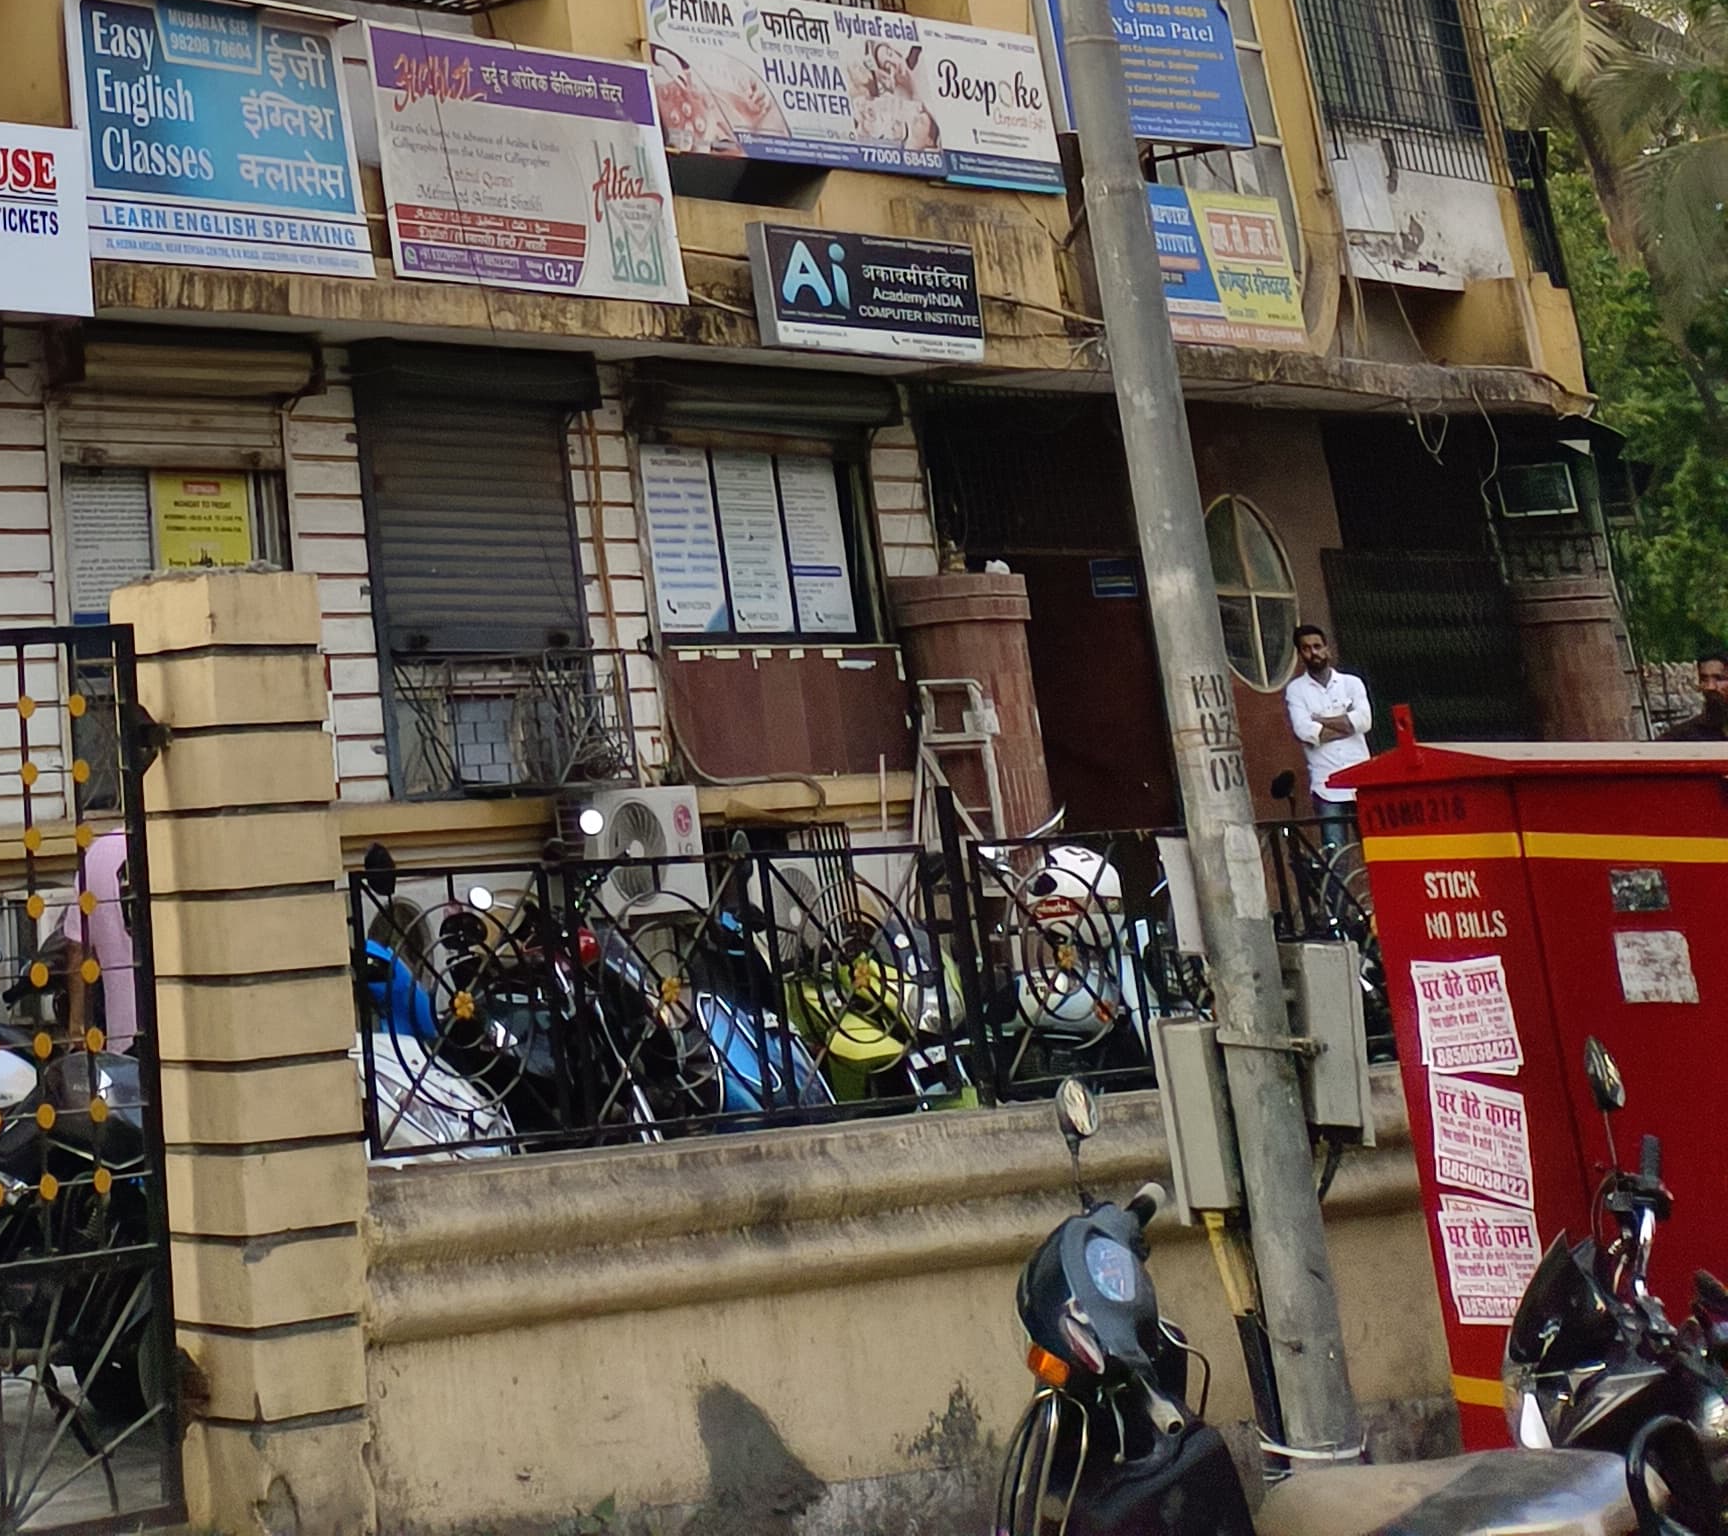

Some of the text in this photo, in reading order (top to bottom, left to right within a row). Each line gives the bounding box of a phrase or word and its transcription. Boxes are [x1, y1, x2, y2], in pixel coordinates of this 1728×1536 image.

[168, 8, 226, 35] MUBARAK
[760, 8, 830, 45] फातिमा
[834, 10, 920, 42] HydraFacial
[1112, 17, 1214, 42] Najma Patel
[92, 10, 156, 71] Easy
[762, 57, 847, 92] HIJAMA
[937, 59, 1042, 117] Bespoke
[96, 67, 195, 128] English
[239, 88, 335, 141] इंग्लिश
[783, 89, 852, 117] CENTER
[102, 126, 214, 181] Classes
[861, 147, 901, 165] 77000
[237, 150, 346, 200] क्लासेस
[592, 158, 664, 223] Alfaz
[102, 204, 356, 246] LEARN ENGLISH SPEAKING
[544, 264, 574, 282] G-27
[782, 240, 851, 310] Ai
[873, 287, 964, 309] AcademyINDIA
[859, 305, 922, 323] COMPUTER
[924, 312, 980, 328] INSTITUTE
[1200, 712, 1232, 746] 07
[1210, 754, 1244, 792] 03
[1424, 870, 1481, 899] STICK
[1425, 910, 1508, 941] NO BILLS
[1419, 969, 1502, 1001] घर बैठे काम
[1436, 1039, 1515, 1066] 8850038422
[1436, 1090, 1521, 1132] घर बैठे काम
[1442, 1158, 1526, 1198] 8850038422
[1446, 1218, 1533, 1248] घर बैठे काम
